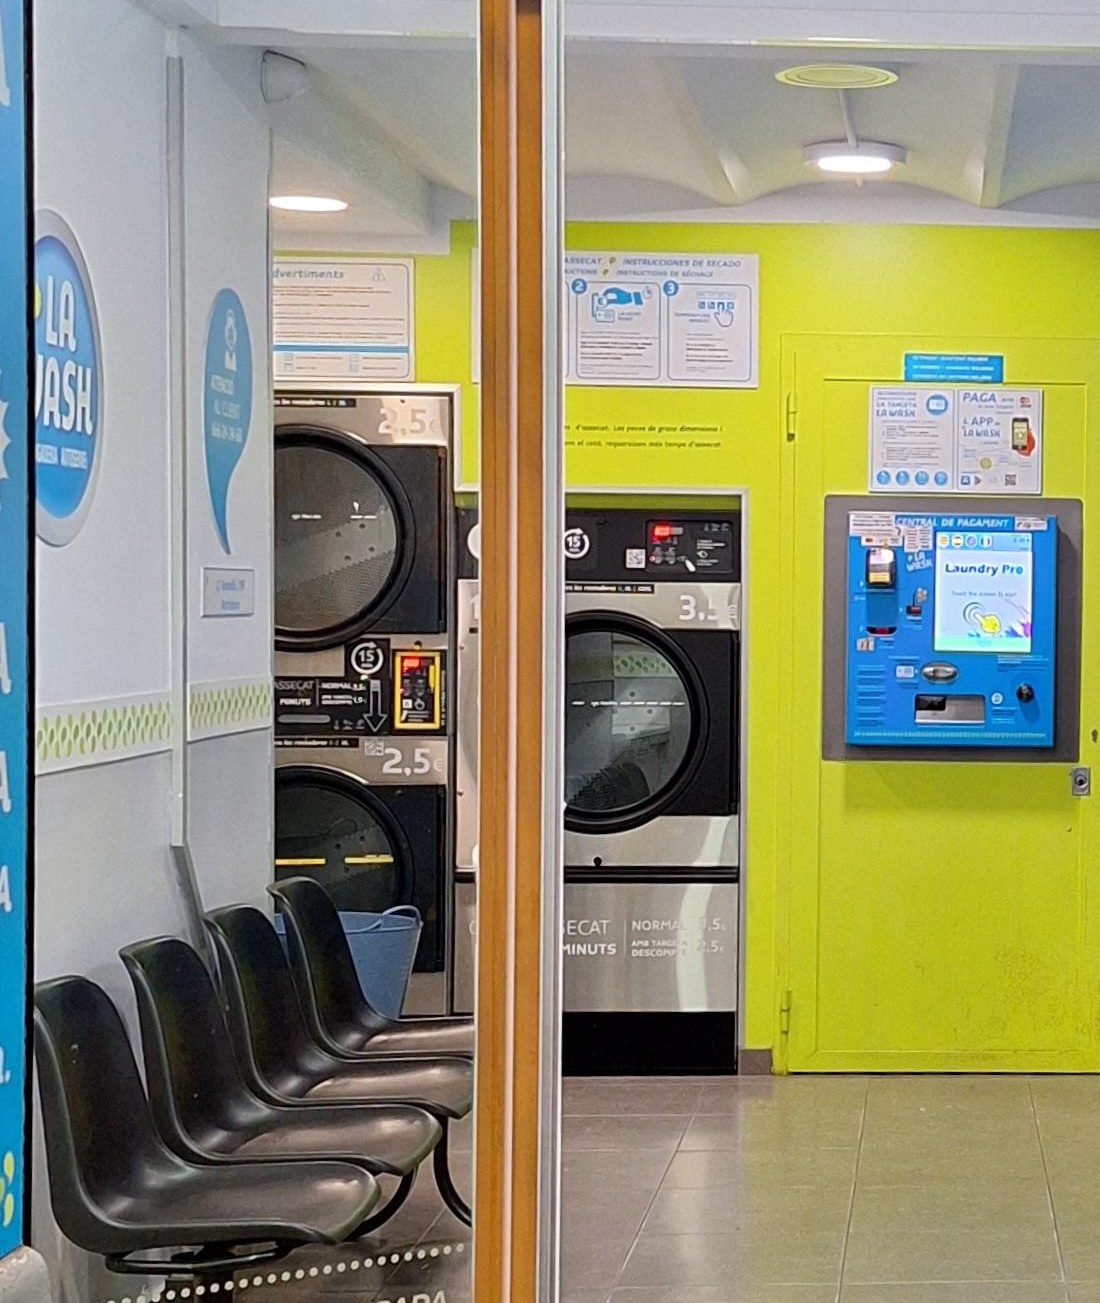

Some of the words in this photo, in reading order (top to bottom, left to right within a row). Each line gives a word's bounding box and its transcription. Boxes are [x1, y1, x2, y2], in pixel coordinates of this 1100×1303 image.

[623, 258, 690, 267] INSTRUCCIONES
[692, 259, 705, 267] DE
[707, 259, 742, 268] SECADO
[574, 281, 585, 293] 2
[666, 283, 675, 295] 3
[46, 274, 77, 353] LA
[962, 392, 997, 403] PAGA
[896, 516, 937, 528] CENTRAL
[941, 518, 954, 527] DE
[957, 518, 1010, 527] PAGAMENT
[566, 536, 581, 548] 15
[945, 563, 998, 576] Laundry
[1002, 564, 1024, 575] Pro
[358, 649, 374, 663] 15
[562, 920, 610, 936] ECAT
[631, 920, 688, 931] NORMA
[651, 939, 687, 948] TARGEA
